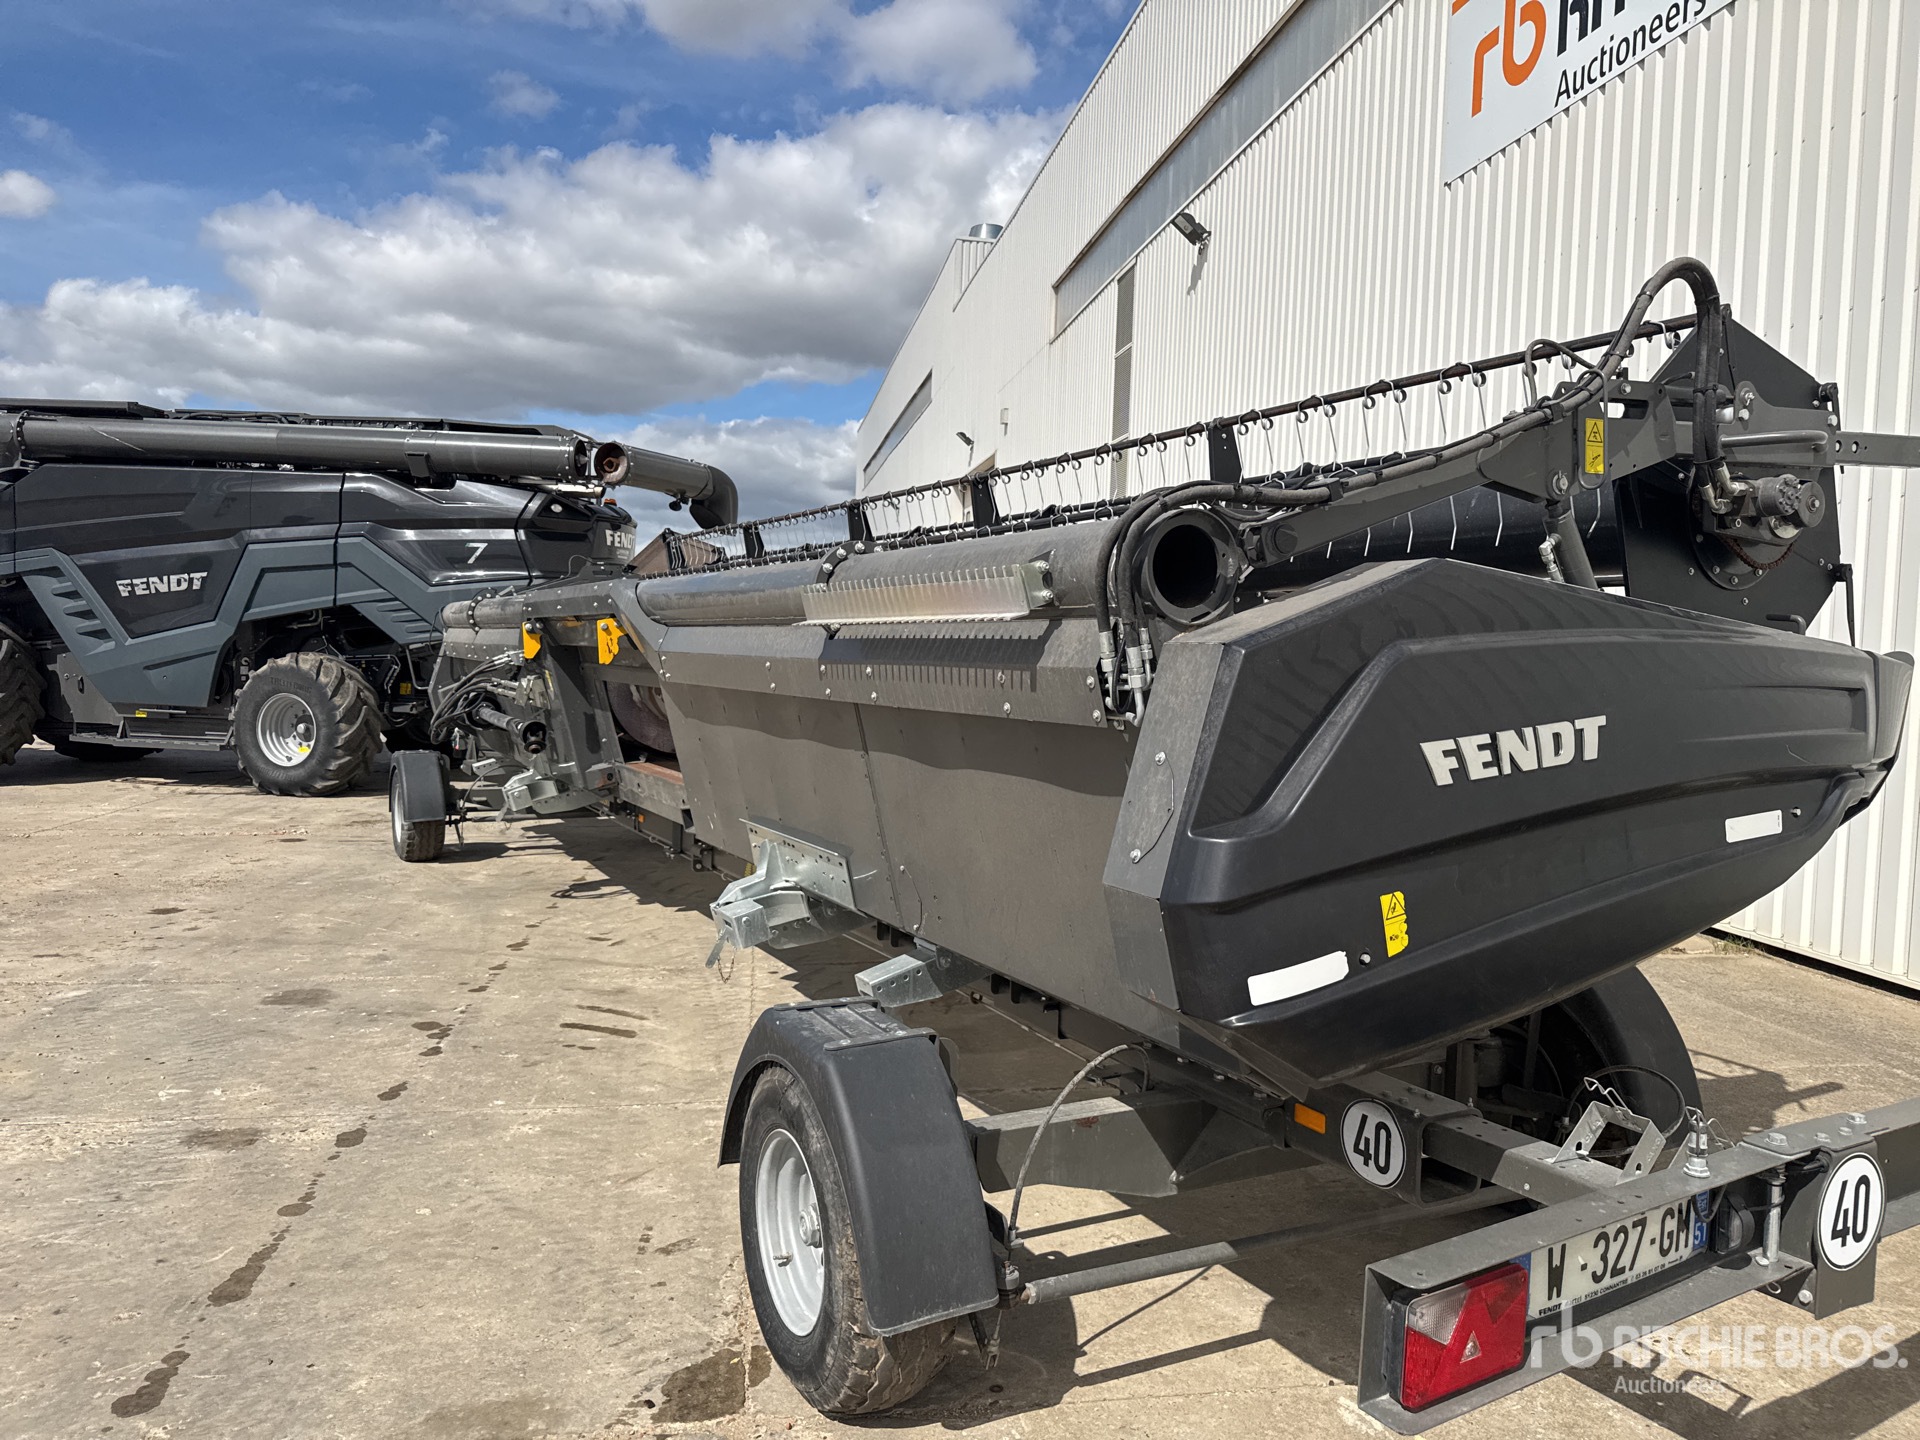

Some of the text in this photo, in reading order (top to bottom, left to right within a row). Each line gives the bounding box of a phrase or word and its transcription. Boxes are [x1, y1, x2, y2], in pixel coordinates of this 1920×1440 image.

[1554, 0, 1706, 108] Auctioneers
[465, 542, 489, 564] 7
[116, 572, 208, 597] FENDT
[1420, 715, 1606, 786] FENDT
[1353, 1113, 1391, 1175] 40
[1694, 1222, 1707, 1245] 51
[1830, 1174, 1870, 1248] 40
